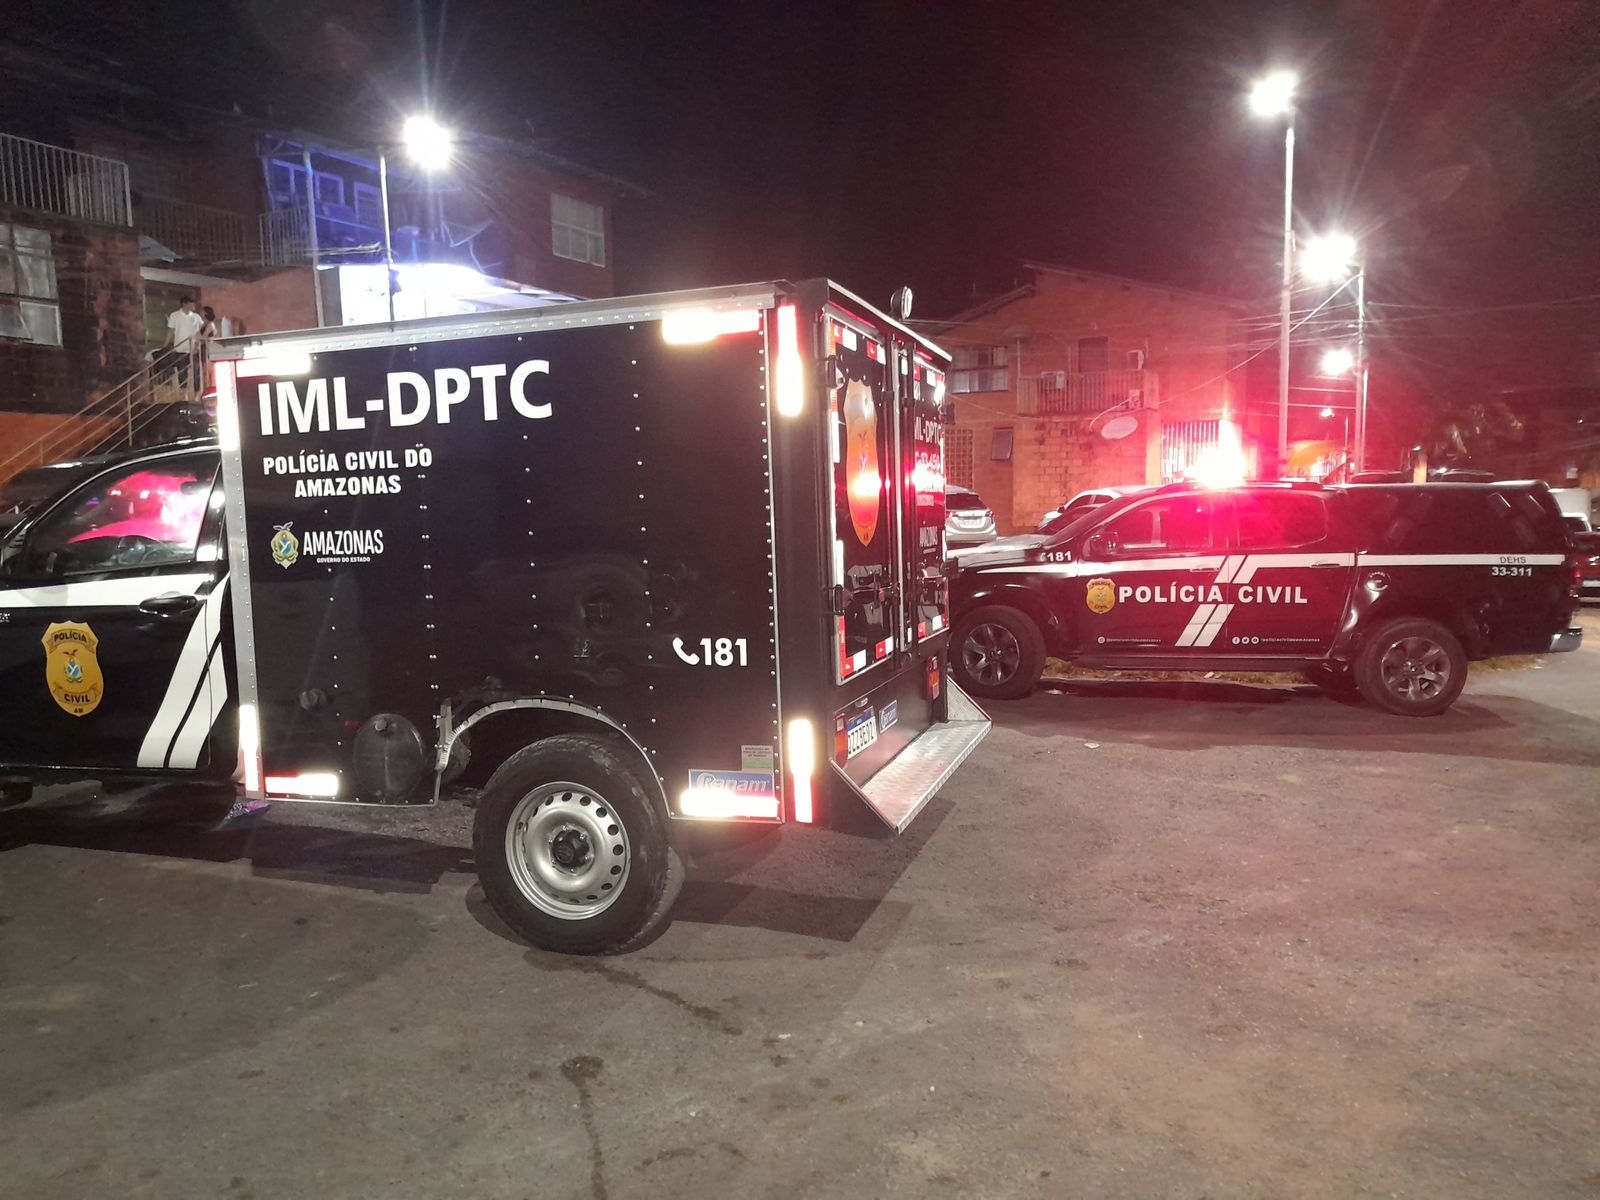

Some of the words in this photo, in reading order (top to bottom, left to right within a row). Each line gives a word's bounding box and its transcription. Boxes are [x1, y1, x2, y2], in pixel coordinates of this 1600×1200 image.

[258, 360, 552, 435] IML-DPTC
[263, 449, 339, 475] POLÍCIA
[345, 450, 398, 471] CIVIL
[405, 448, 432, 468] DO
[295, 475, 401, 498] AMAZONAS
[303, 529, 384, 555] AMAZONAS
[1047, 551, 1072, 562] 181
[1500, 556, 1527, 564] DEHS
[1491, 567, 1532, 577] 33-311
[1119, 582, 1223, 603] POLÍCIA
[1238, 586, 1308, 604] CIVIL
[54, 630, 87, 642] POLÍCIA
[700, 638, 747, 667] 181
[64, 694, 90, 703] CIVIL
